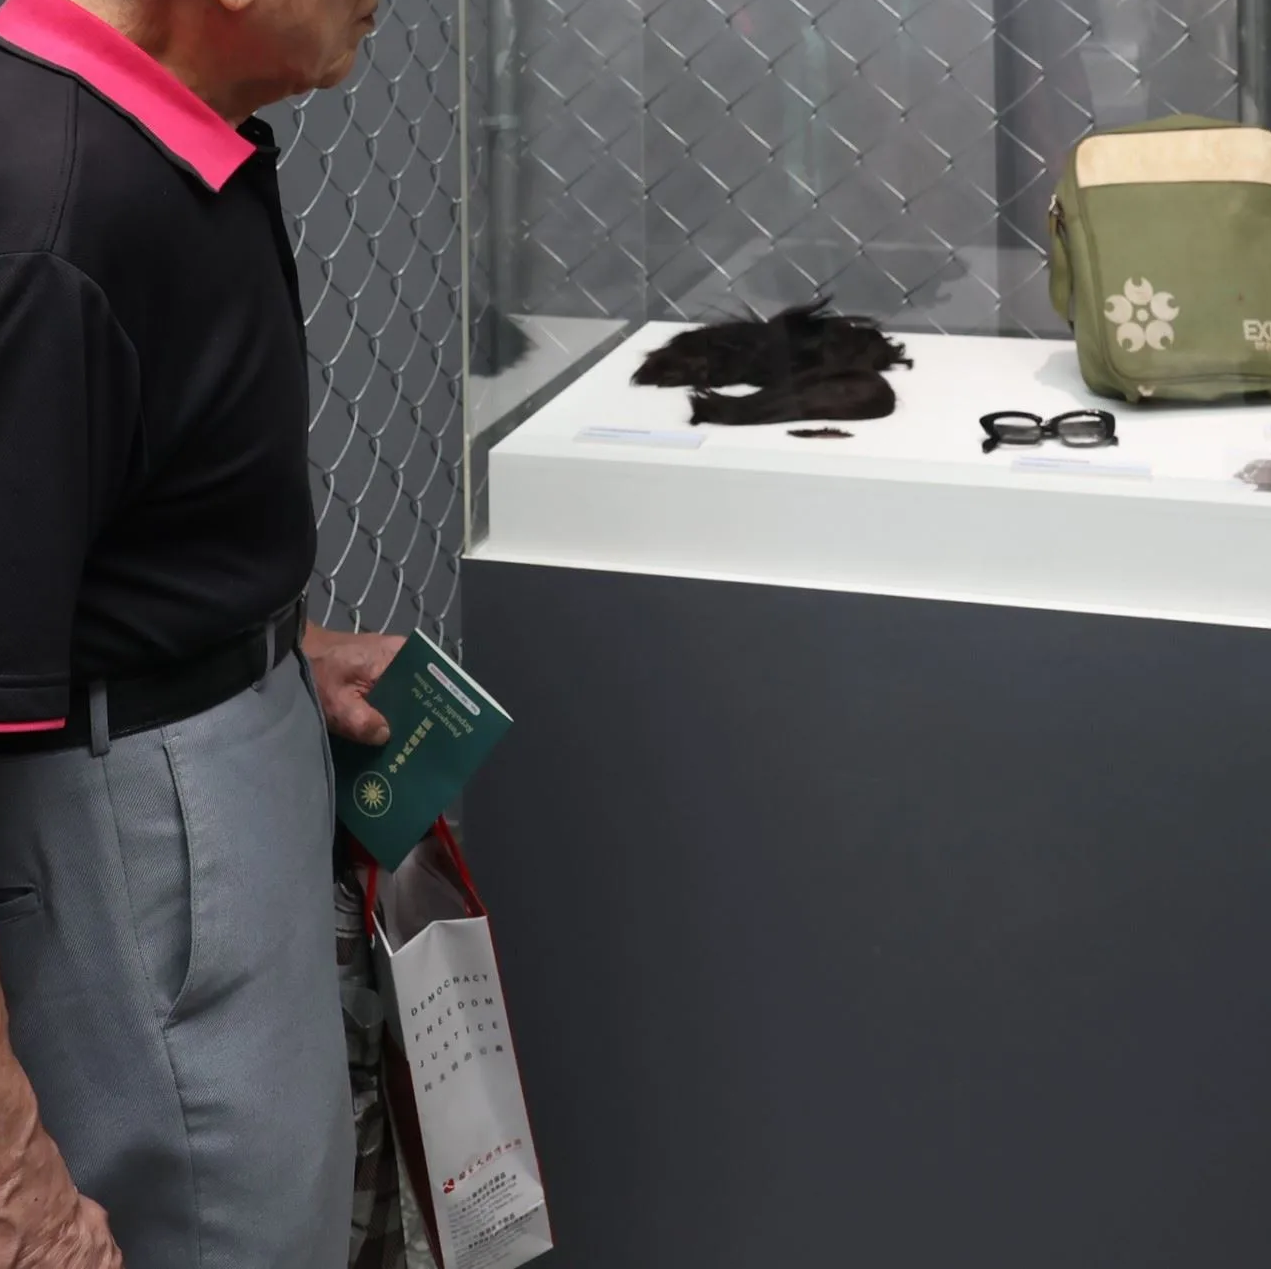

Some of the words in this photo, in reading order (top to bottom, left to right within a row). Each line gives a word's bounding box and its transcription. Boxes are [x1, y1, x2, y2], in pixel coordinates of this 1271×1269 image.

[410, 973, 488, 1017] DEMOCRACY
[415, 997, 494, 1042] FREEDOM
[419, 1020, 498, 1068] JUSTICE
